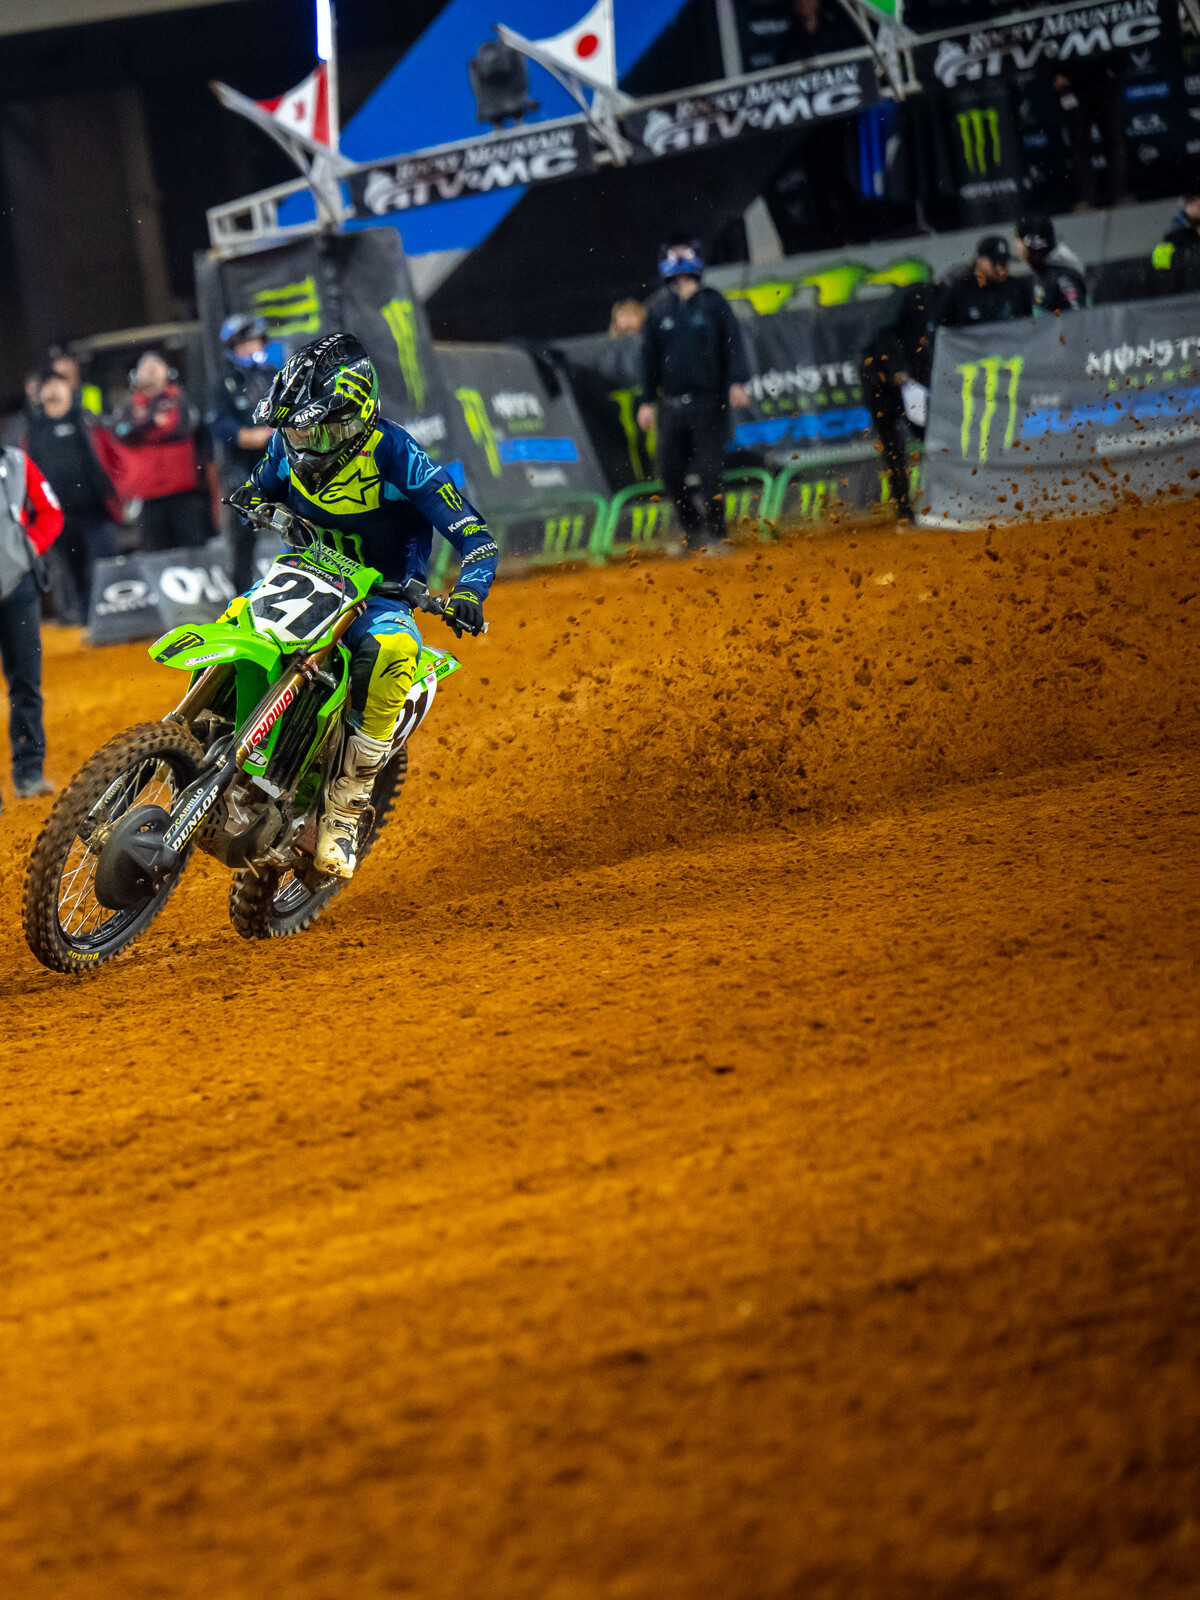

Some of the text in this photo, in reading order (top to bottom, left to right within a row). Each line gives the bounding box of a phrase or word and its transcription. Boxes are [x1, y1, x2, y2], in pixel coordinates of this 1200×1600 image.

[314, 333, 343, 355] AIROH
[1085, 335, 1200, 376] MONST
[294, 404, 323, 424] Airoh
[309, 550, 357, 577] RNTHAL
[317, 543, 362, 571] ENTHAL
[304, 564, 334, 582] MONSTER
[251, 572, 347, 640] 21
[252, 689, 294, 747] SHOWA
[171, 785, 220, 851] DUNLOP
[175, 788, 204, 825] CARRILLO
[67, 950, 100, 961] DUNLOP
